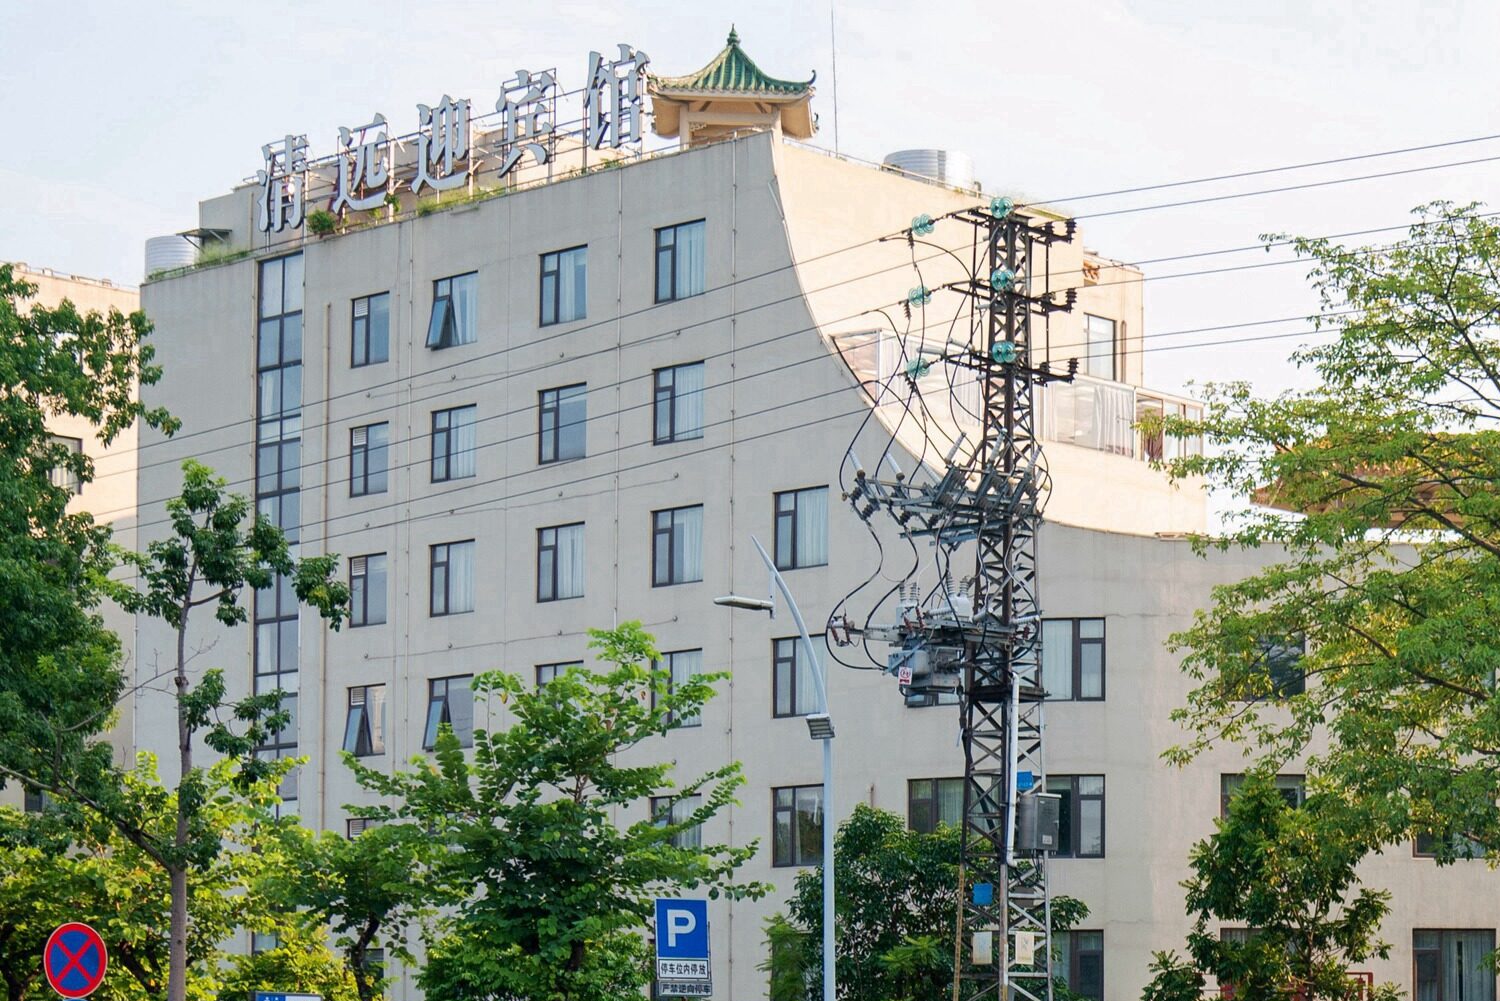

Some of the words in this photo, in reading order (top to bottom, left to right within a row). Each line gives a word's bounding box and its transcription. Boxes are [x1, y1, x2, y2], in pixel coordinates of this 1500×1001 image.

[257, 43, 650, 232] 清远迎宾馆
[667, 909, 697, 947] P
[661, 963, 706, 975] 停车位内停放
[662, 983, 711, 994] 严禁逆向停车
